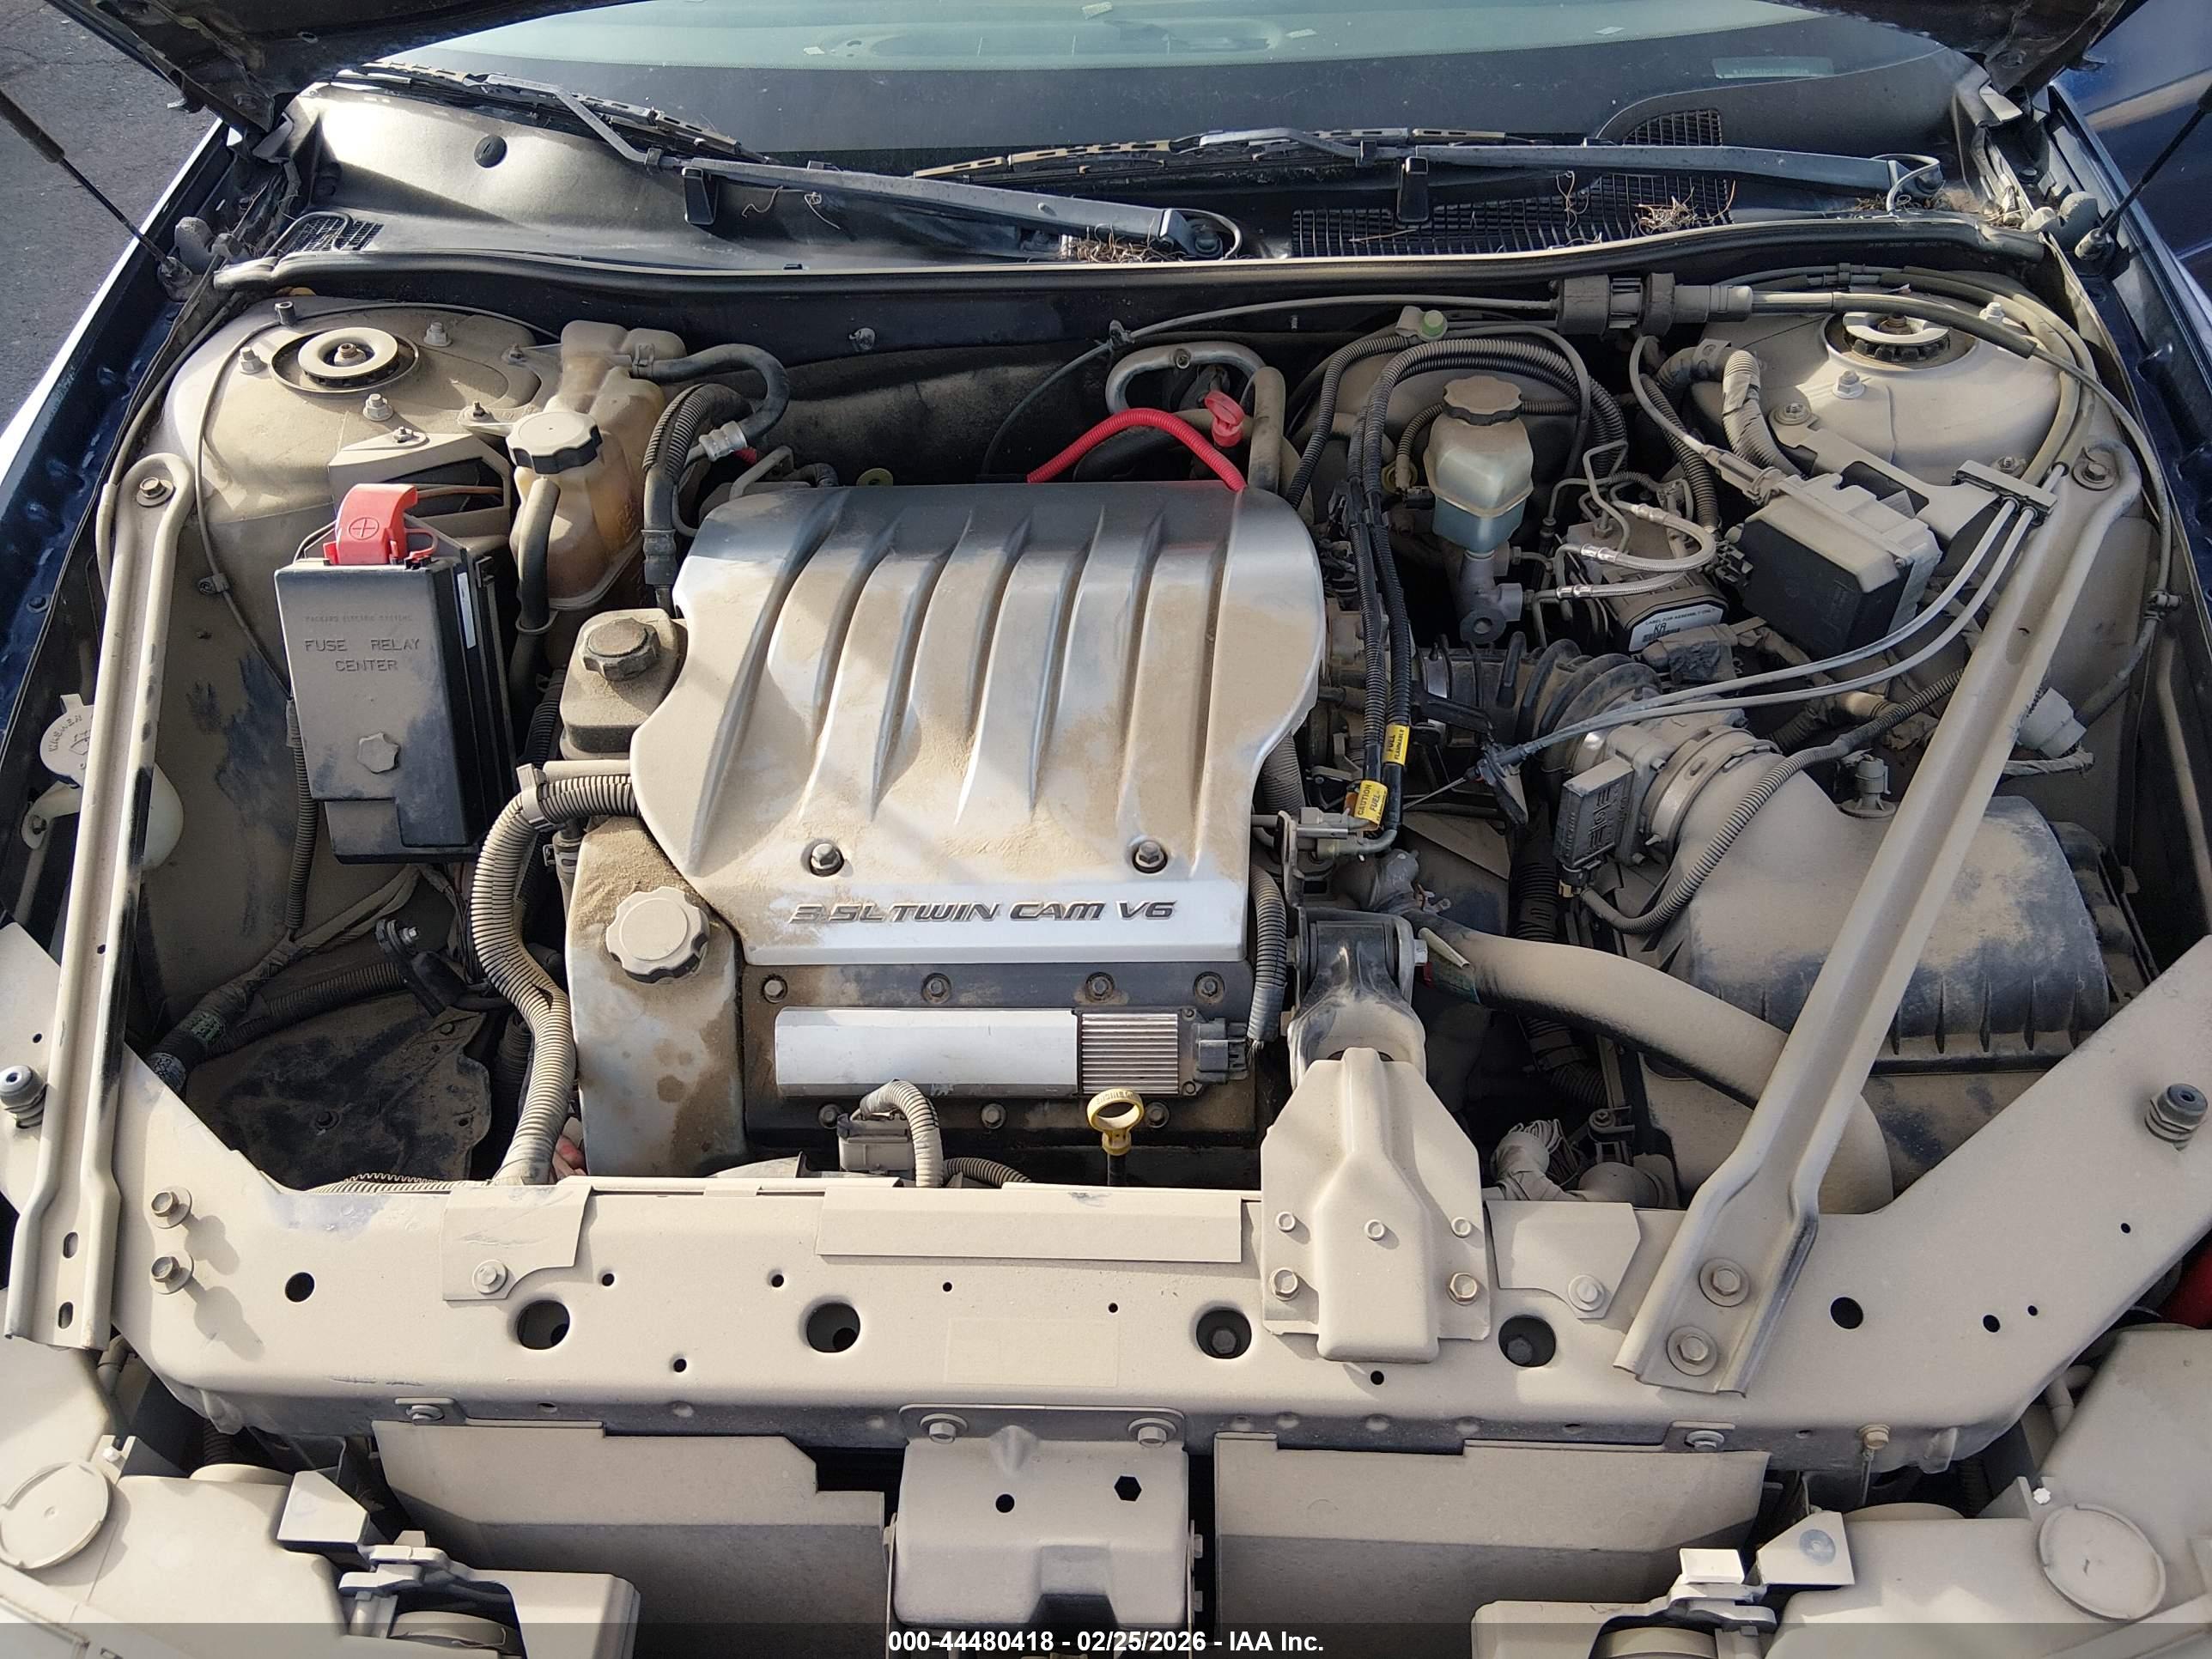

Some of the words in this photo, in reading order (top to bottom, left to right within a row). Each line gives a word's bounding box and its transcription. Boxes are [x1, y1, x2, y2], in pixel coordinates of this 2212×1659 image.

[304, 639, 348, 653] FUSE
[370, 638, 420, 652] RELAY
[335, 659, 398, 672] CENTER
[1357, 783, 1373, 816] CAUTION
[1369, 793, 1381, 812] FUEL
[788, 902, 886, 924] 3.5L
[890, 902, 1000, 923] TWIN
[1009, 901, 1107, 921] CAM
[1115, 899, 1178, 921] V6
